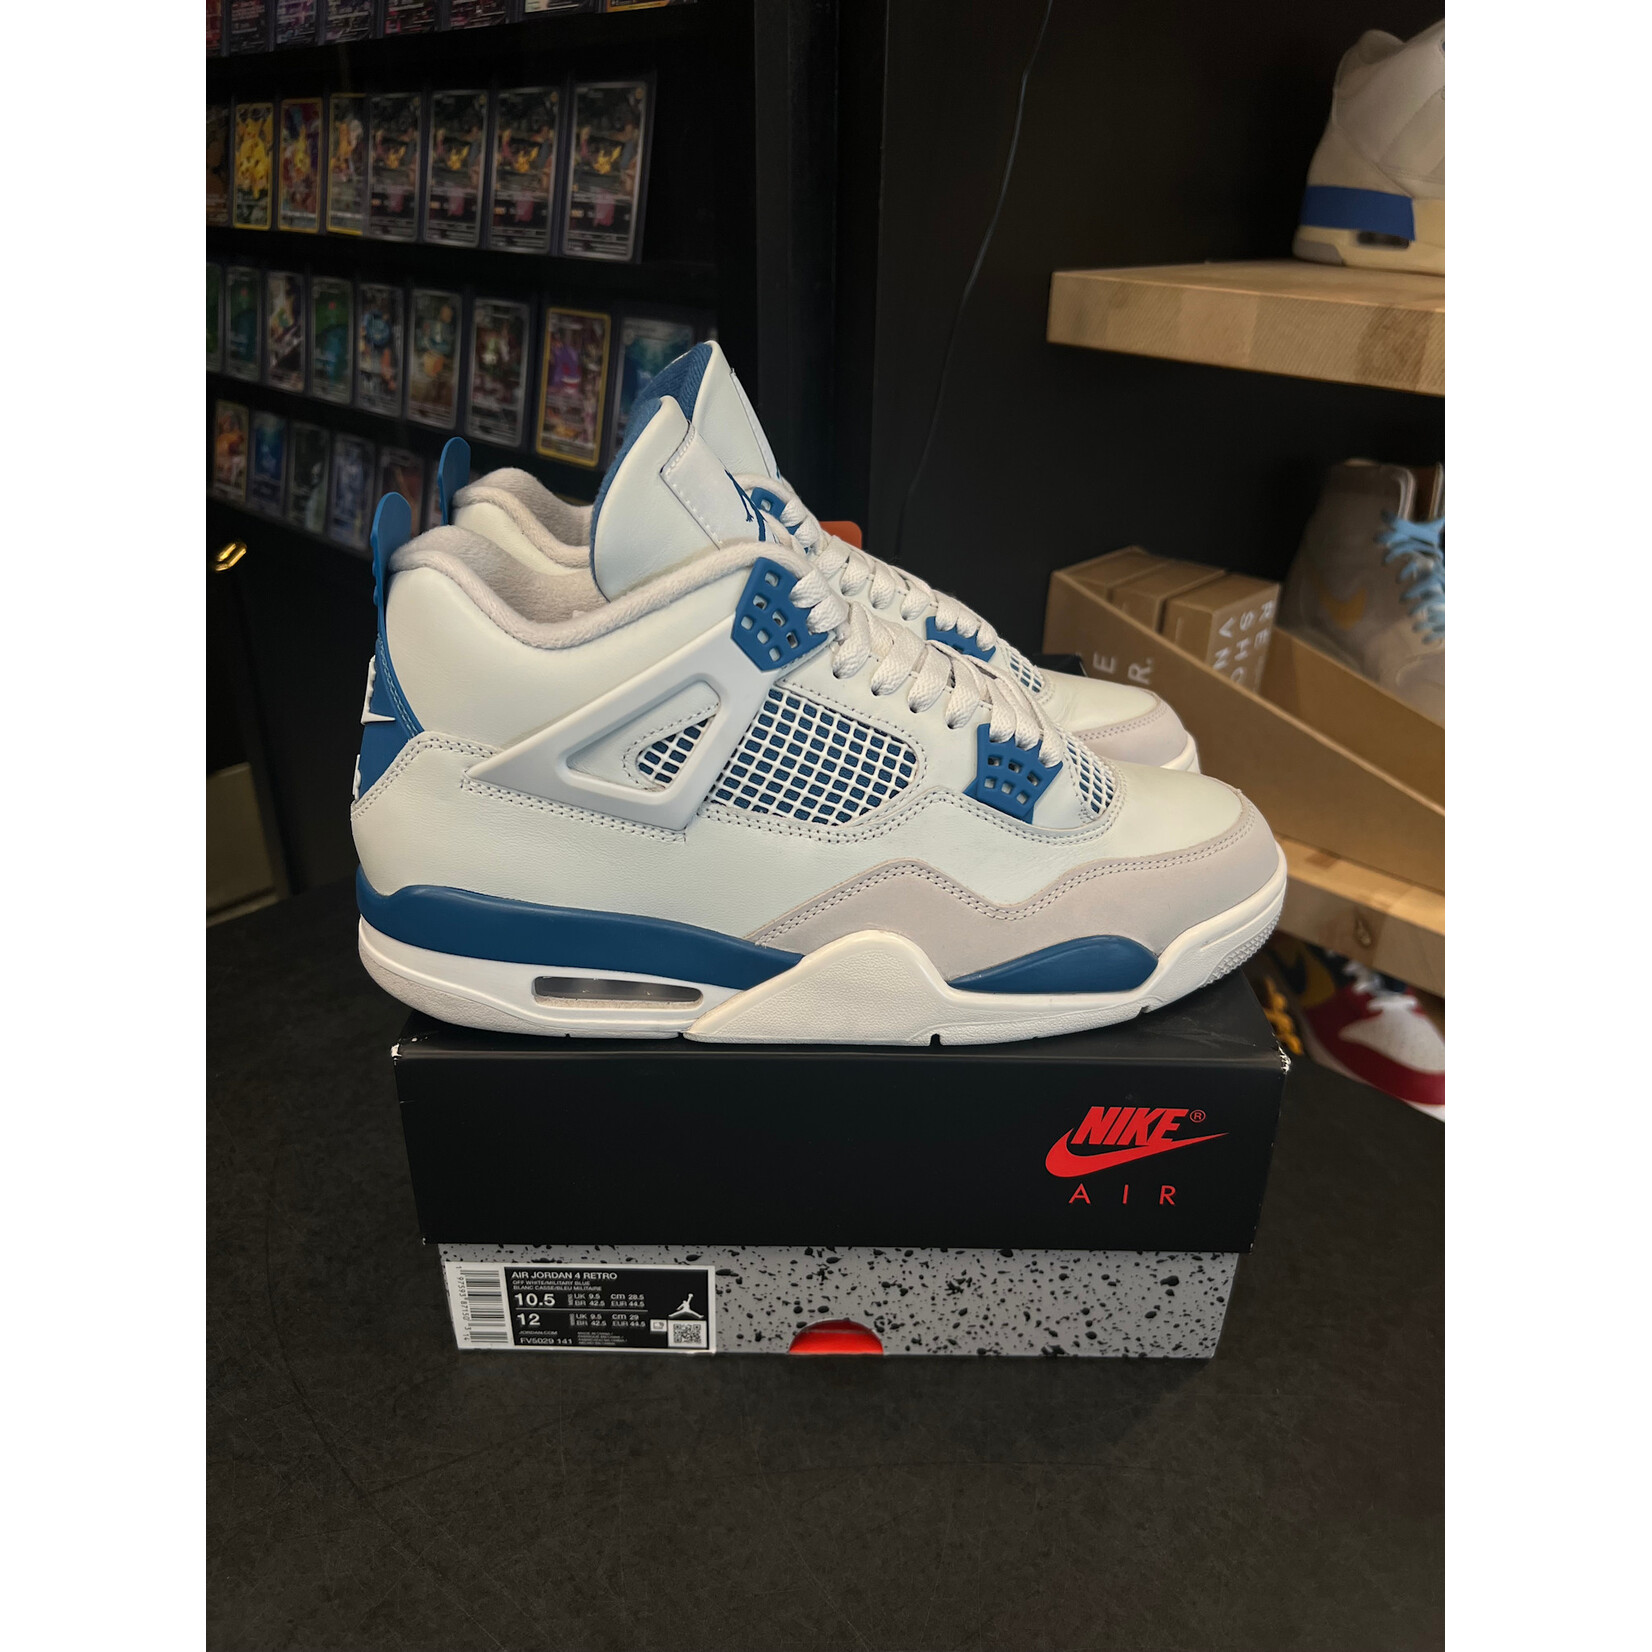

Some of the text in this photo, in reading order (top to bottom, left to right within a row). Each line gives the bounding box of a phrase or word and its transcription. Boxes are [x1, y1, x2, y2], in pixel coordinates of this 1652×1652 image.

[1230, 610, 1255, 684] SHO
[1070, 1106, 1190, 1147] NIKE
[1068, 1183, 1176, 1206] AIR
[511, 1271, 529, 1279] AIR
[531, 1271, 572, 1279] JORDAN
[583, 1272, 618, 1280] RETRO
[514, 1292, 556, 1306] 10.5
[516, 1313, 541, 1326] 12
